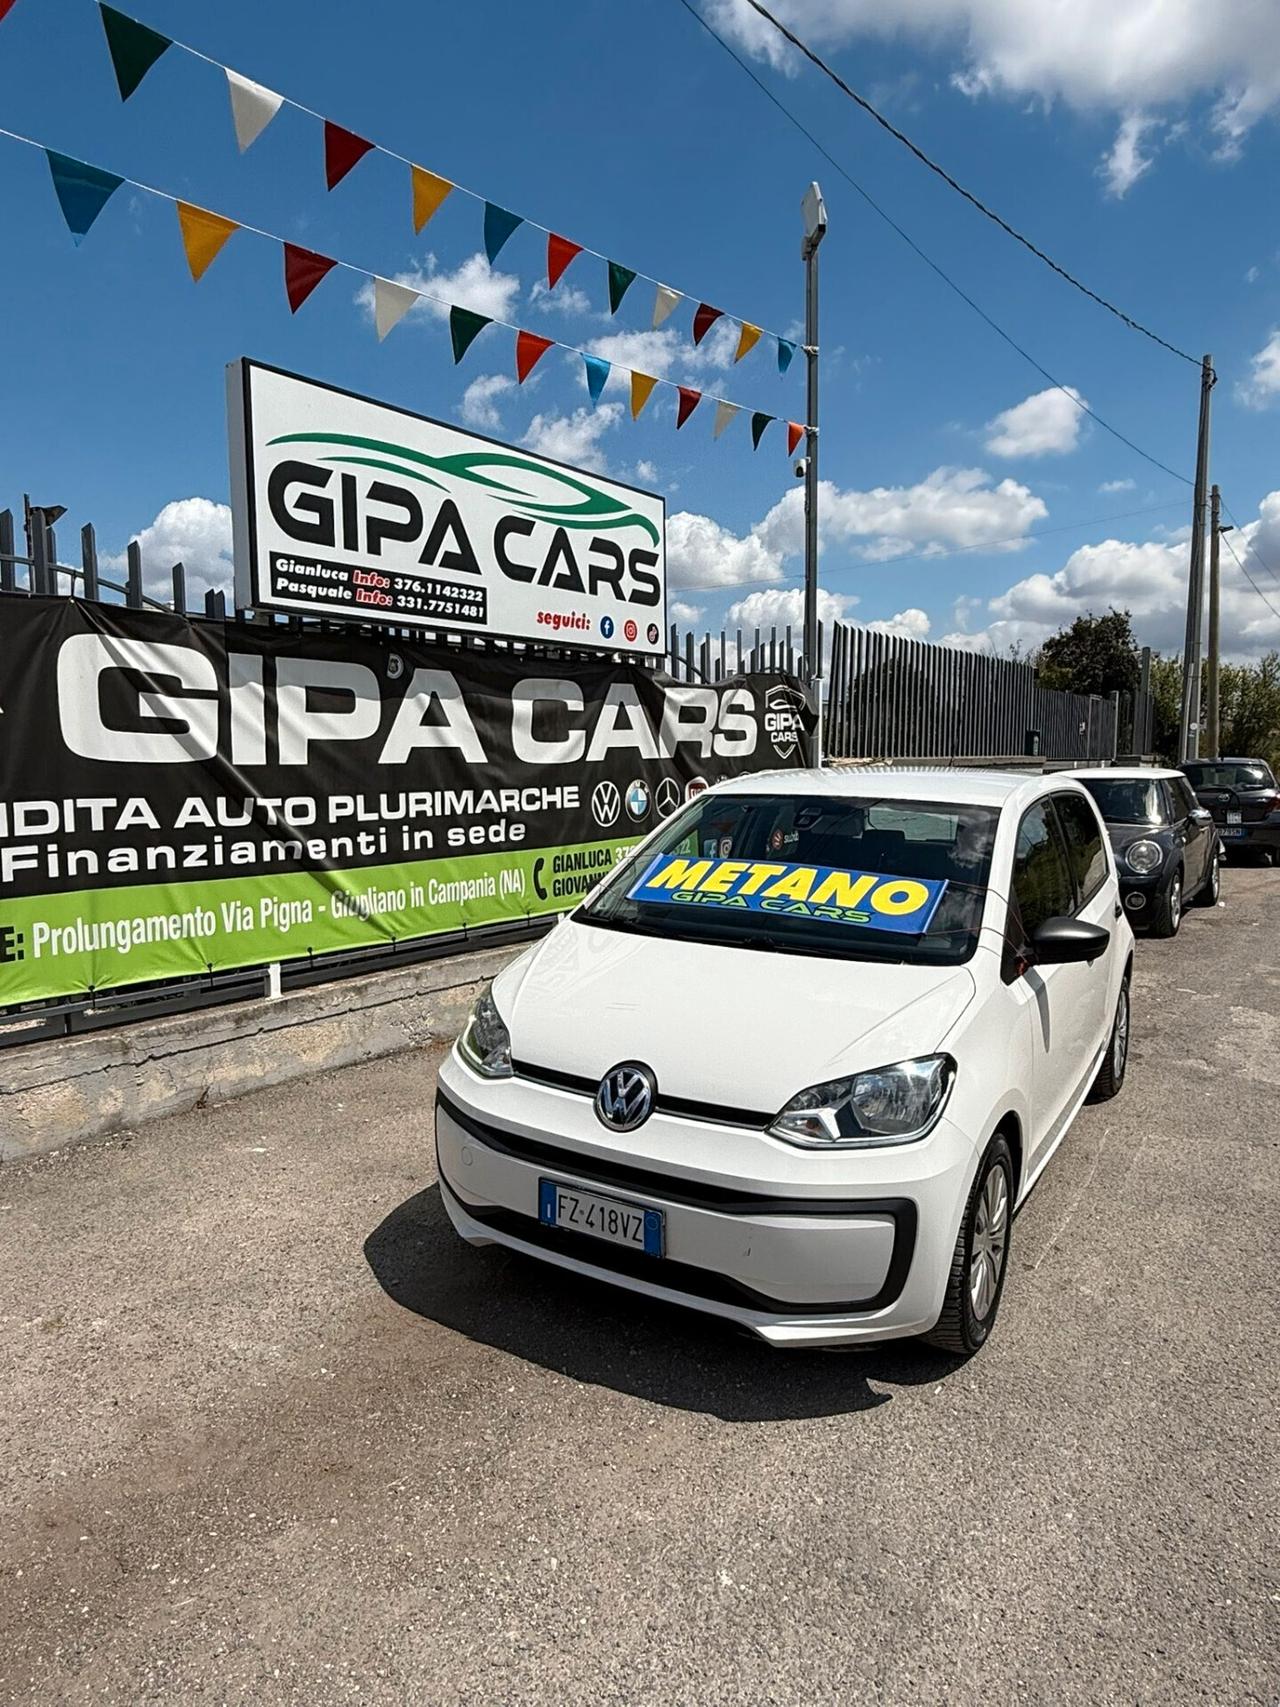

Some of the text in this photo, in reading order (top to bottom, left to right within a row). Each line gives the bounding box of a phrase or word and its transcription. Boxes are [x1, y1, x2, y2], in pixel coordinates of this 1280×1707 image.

[267, 460, 661, 607] GIPA CARS
[275, 558, 483, 602] Gianluca Info: 376.1142322
[276, 577, 484, 618] Pasquale Info: 331.7751481
[536, 610, 590, 632] seguici:
[57, 633, 758, 766] GIPA CARS
[764, 713, 806, 731] GIPA
[770, 731, 799, 743] CARS
[174, 796, 317, 829] AUTO
[328, 785, 581, 824] PLURIMARCHE
[2, 821, 526, 883] Finanziamenti in sede
[553, 848, 613, 874] GIANLUCA
[645, 858, 930, 916] METANO
[671, 891, 873, 924] GIPA CARS
[32, 906, 216, 959] Prolungamento
[221, 902, 254, 933] Via
[260, 897, 313, 933] Pigna
[331, 886, 406, 921] Giugliano
[411, 885, 425, 908] in
[428, 873, 496, 907] Campania
[499, 868, 526, 899] (NA)
